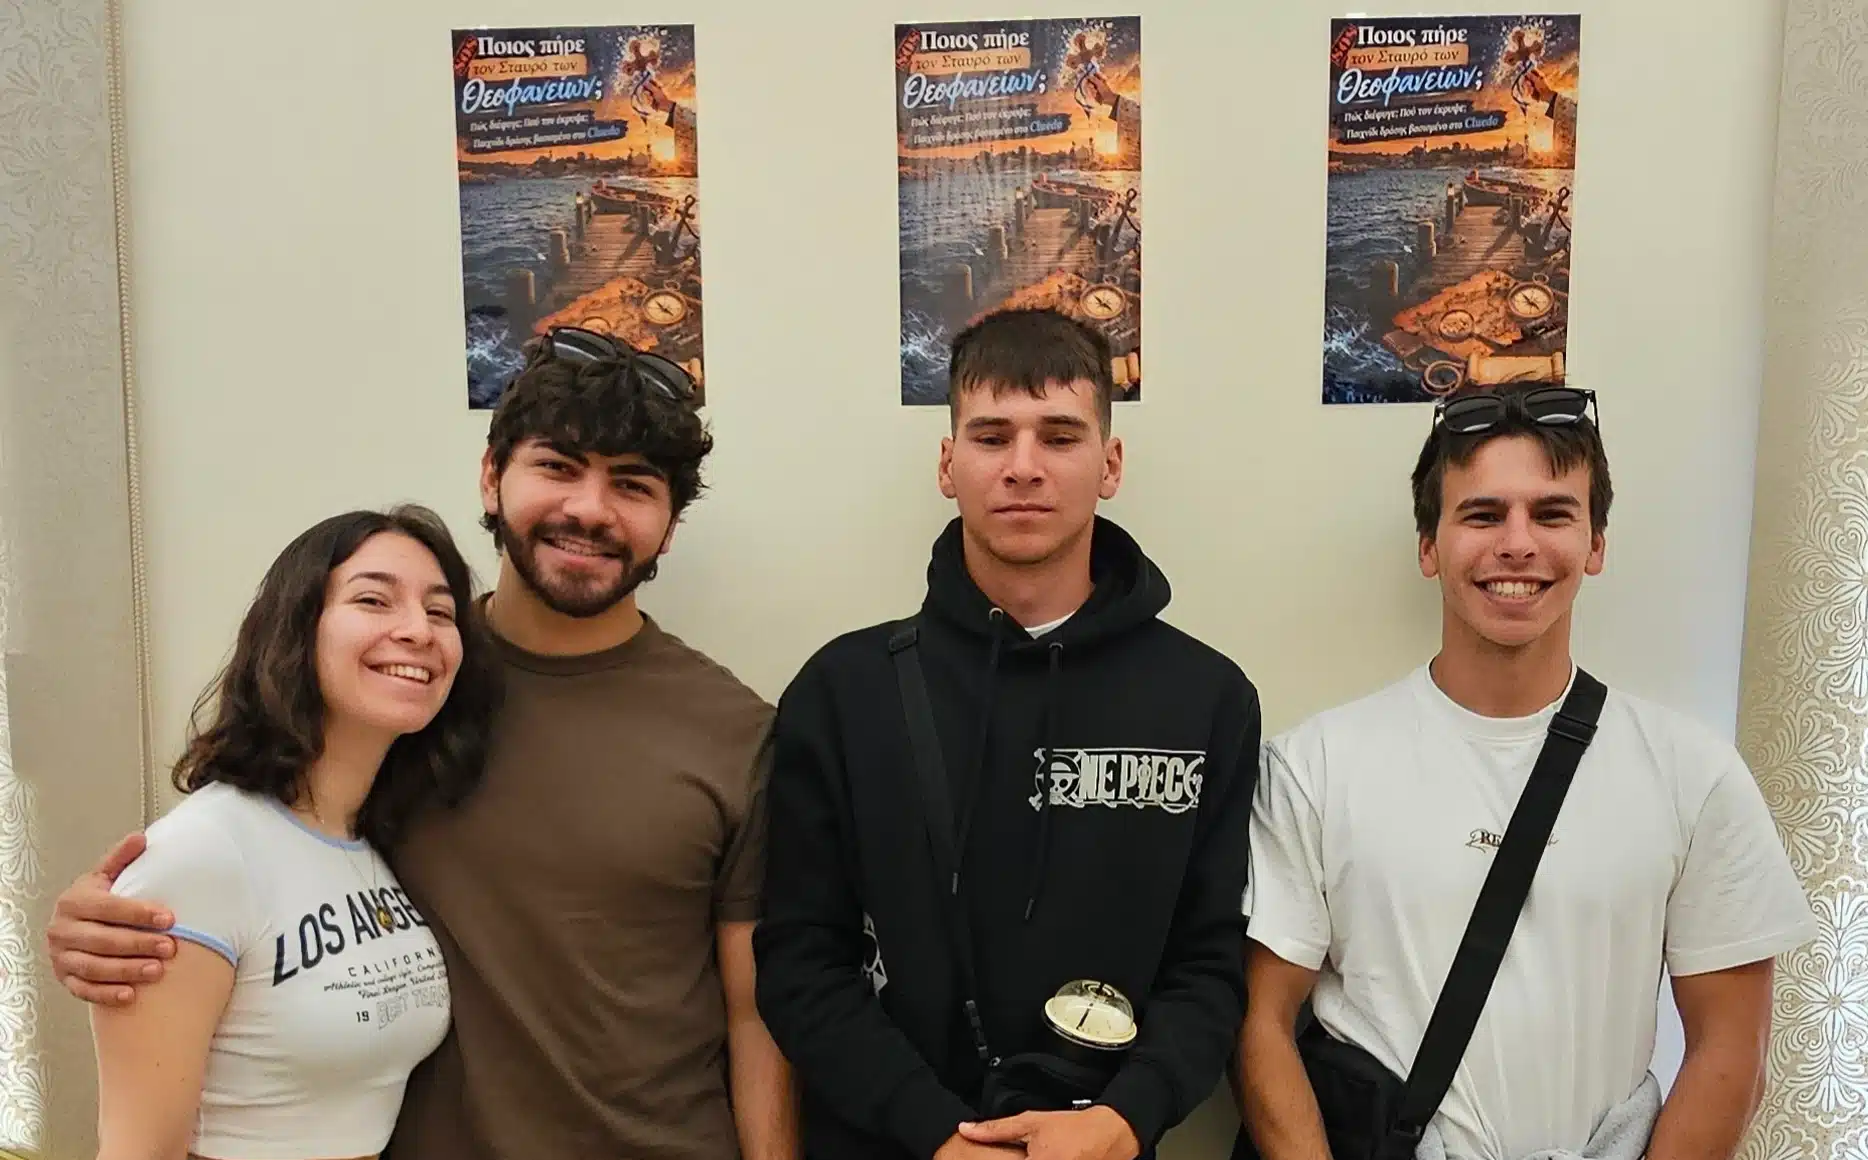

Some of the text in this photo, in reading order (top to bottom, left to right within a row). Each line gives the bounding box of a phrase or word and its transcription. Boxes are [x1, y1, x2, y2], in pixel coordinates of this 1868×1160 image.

[478, 36, 535, 57] Ποιος
[539, 35, 585, 56] πήρε
[920, 30, 978, 51] Ποιος
[984, 29, 1029, 50] πήρε
[1357, 25, 1415, 46] Ποιος
[1420, 24, 1468, 45] πήρε
[472, 60, 578, 76] τον Σταυρό των
[915, 54, 1021, 70] τον Σταυρό των
[1351, 49, 1460, 65] τον Σταυρό των
[462, 74, 603, 116] Θεοφανείων;
[903, 69, 1047, 111] Θεοφανείων;
[1336, 65, 1483, 107] Θεοφανείων;
[1418, 106, 1432, 116] τον
[1449, 121, 1463, 130] στο
[1464, 114, 1499, 129] Cluedo
[272, 903, 345, 987] LOS
[348, 945, 440, 977] CALIFORN
[356, 1010, 370, 1023] 19
